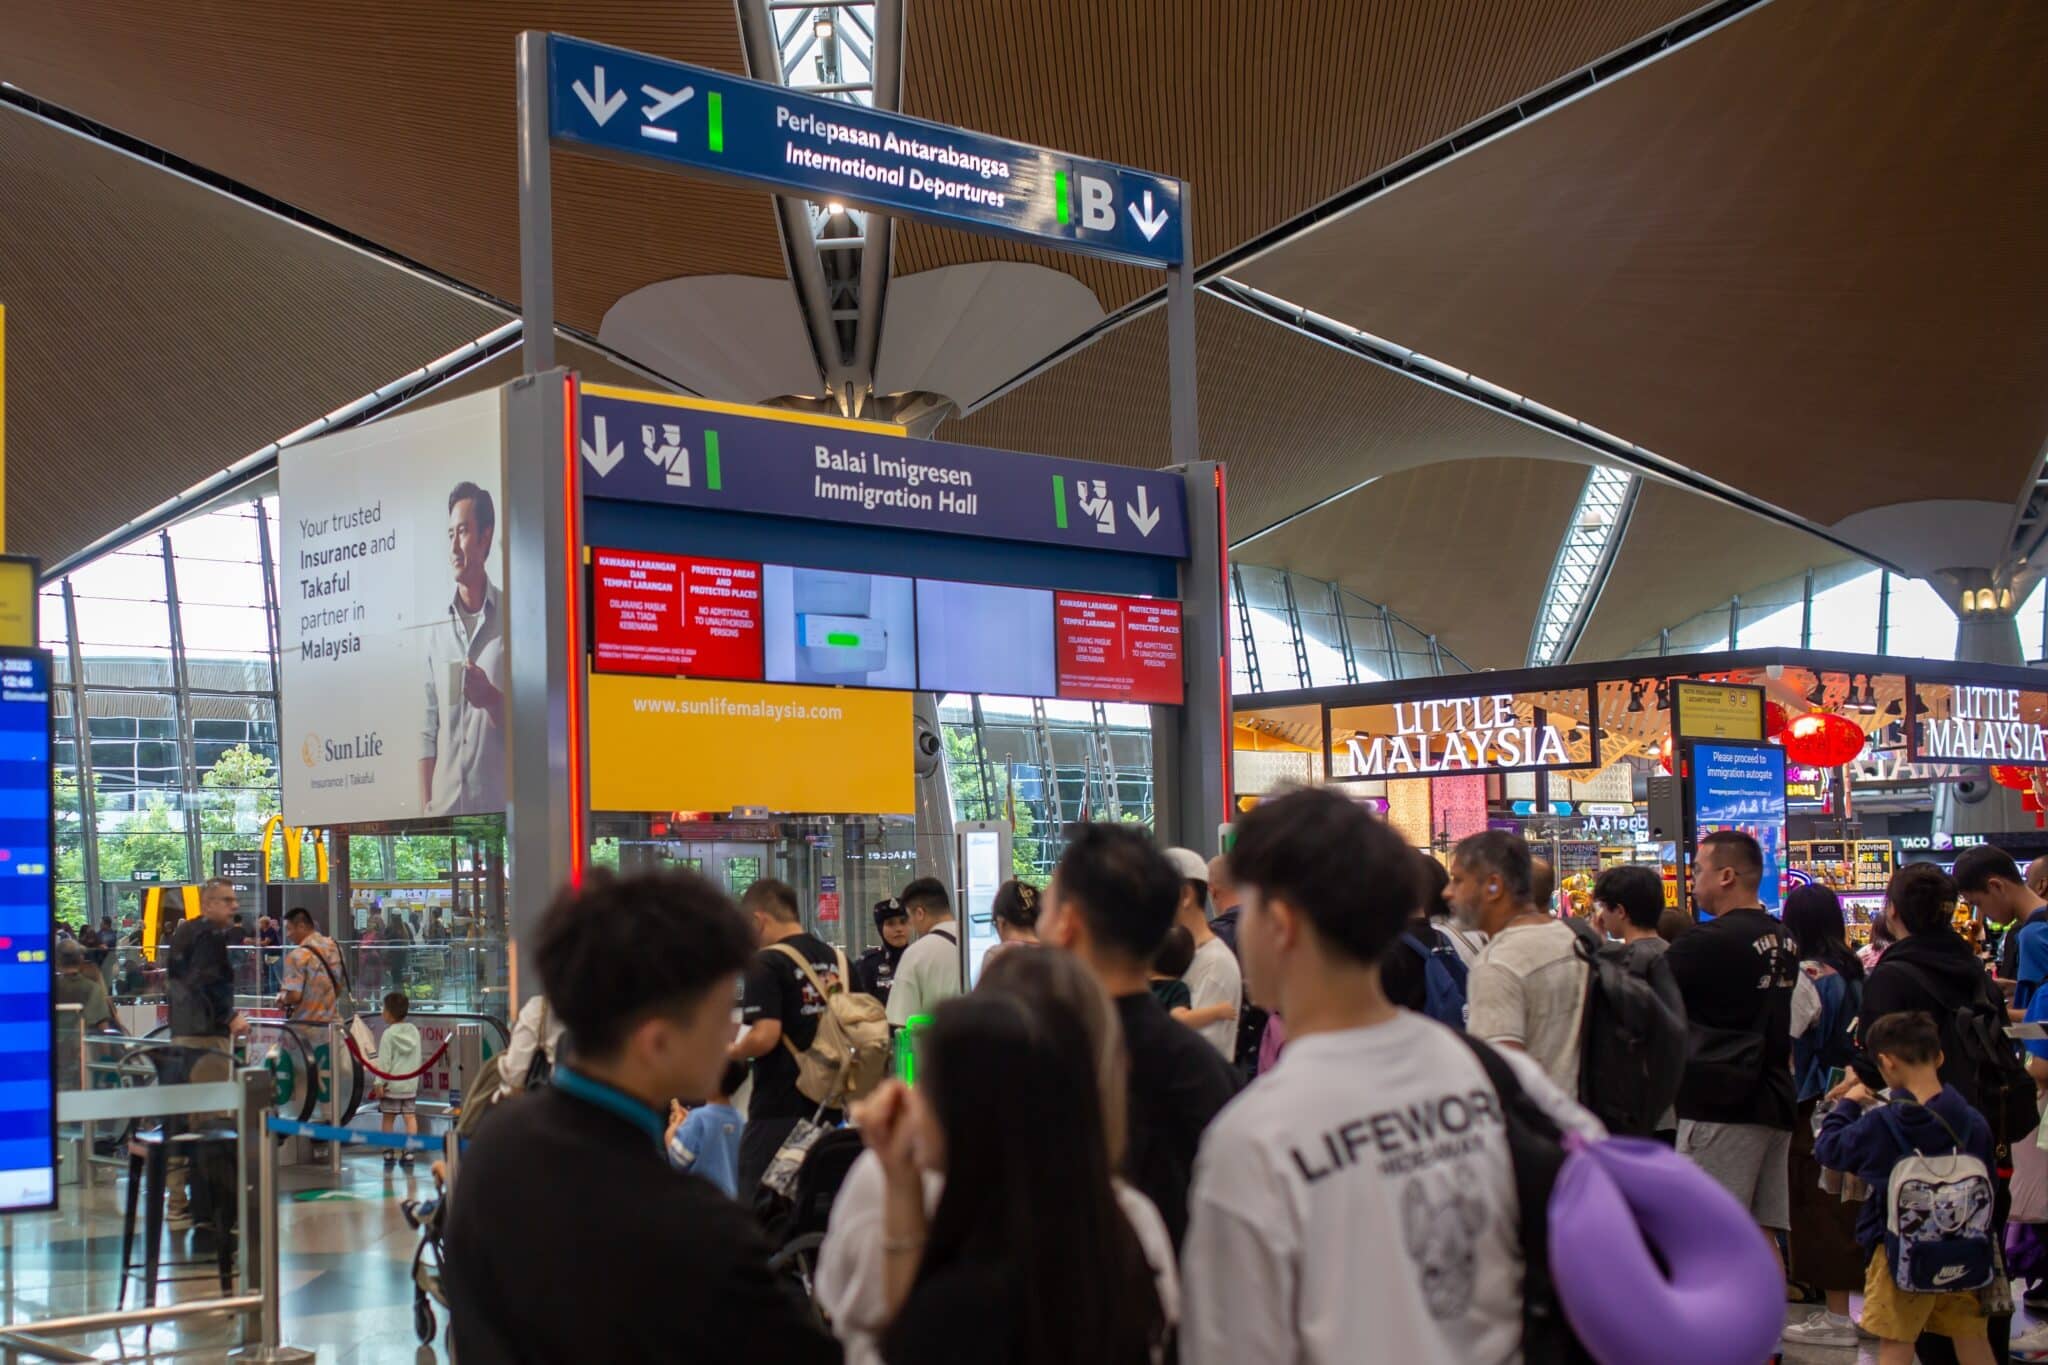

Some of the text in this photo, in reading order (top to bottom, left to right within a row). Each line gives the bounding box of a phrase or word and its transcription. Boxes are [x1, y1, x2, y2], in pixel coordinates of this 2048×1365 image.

[776, 106, 1009, 178] Perlepasan Antarabangsa
[786, 142, 1005, 208] International Departures
[1080, 176, 1116, 232] B
[815, 445, 972, 486] Balai Imigresen
[815, 475, 977, 515] Immigration Hall
[299, 500, 381, 539] Your trusted
[300, 529, 396, 569] Insurance and
[599, 557, 676, 572] KAWASAN LARANGAN
[630, 570, 646, 579] DAN
[691, 565, 755, 579] PROTECTED AREAS
[300, 571, 350, 600] Takaful
[603, 578, 673, 592] TEMPAT LARANGAN
[690, 585, 757, 599] PROTECTED PLACES
[716, 578, 732, 587] AND
[301, 600, 365, 636] partner in
[695, 616, 705, 625] TO
[699, 607, 709, 615] NO
[301, 633, 361, 661] Malaysia
[633, 697, 842, 722] www.sunlifemalaysia.com
[1392, 694, 1517, 735] LITTLE
[1955, 685, 2020, 721] LITTLE
[325, 731, 383, 762] Sun Life
[1347, 725, 1571, 776] MALAYSIA
[1927, 718, 2047, 761] MALAYSIA
[1707, 765, 1745, 780] immigration
[1746, 769, 1773, 781] autogate
[1713, 752, 1767, 765] Please proceed to
[1901, 835, 1988, 848] TACO BELL
[1290, 1090, 1507, 1183] LIFEWOR
